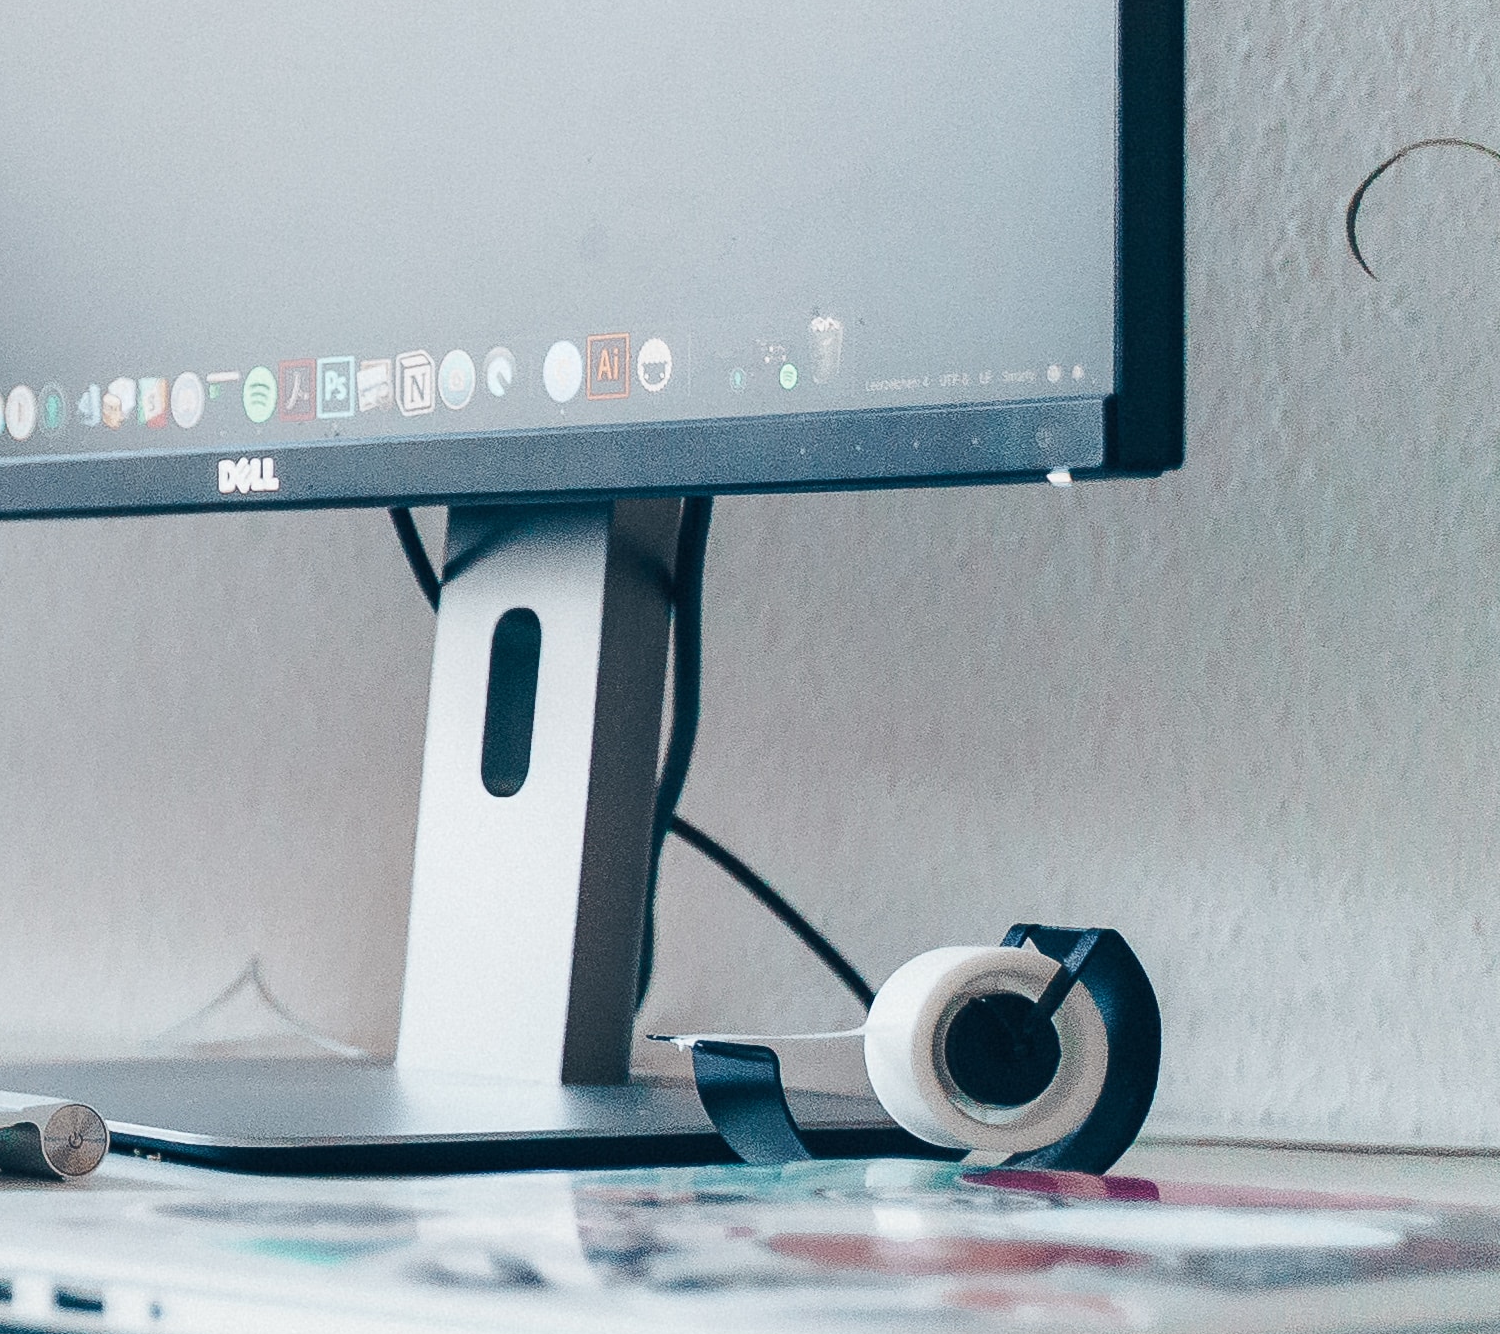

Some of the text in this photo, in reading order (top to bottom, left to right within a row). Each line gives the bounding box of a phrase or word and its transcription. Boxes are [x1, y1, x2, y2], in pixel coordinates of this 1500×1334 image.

[596, 347, 619, 381] Ai
[324, 370, 347, 401] Ps
[410, 372, 426, 404] N
[218, 456, 280, 494] DELL
